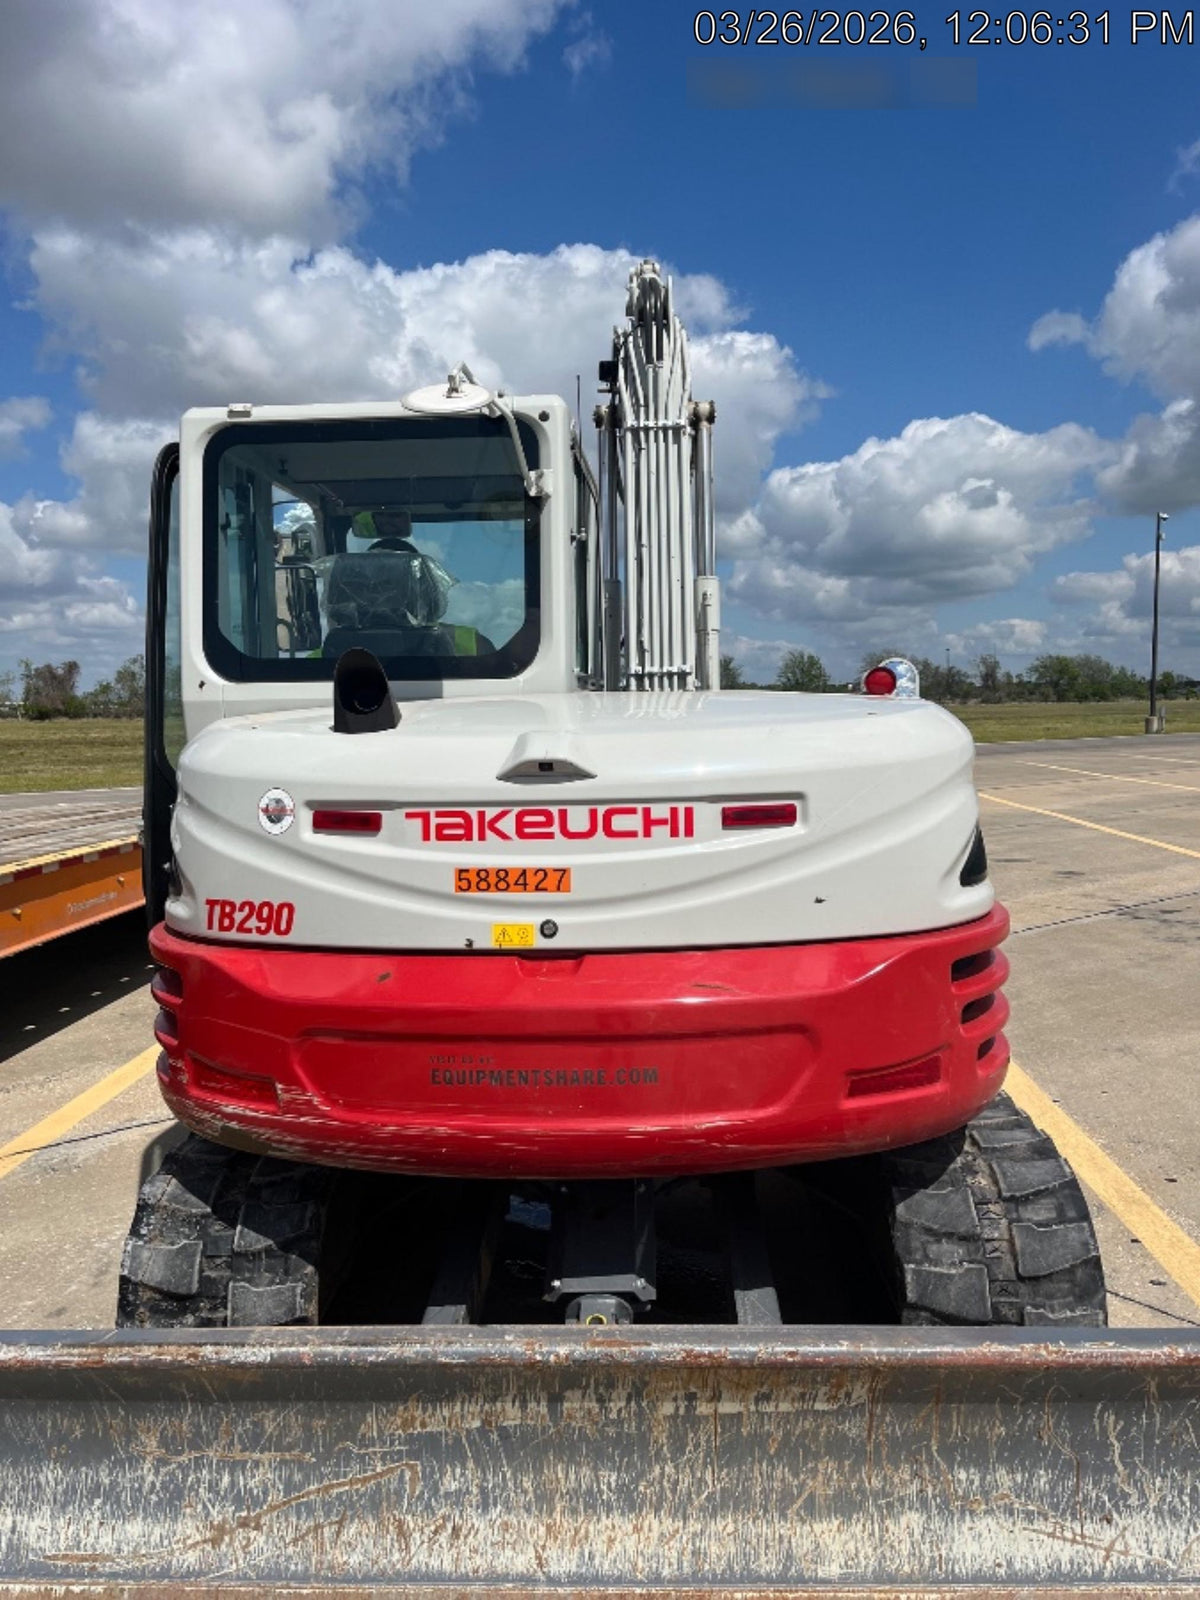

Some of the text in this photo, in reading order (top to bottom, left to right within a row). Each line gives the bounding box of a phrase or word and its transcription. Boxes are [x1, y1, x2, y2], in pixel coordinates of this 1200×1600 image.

[456, 868, 568, 893] 588427
[205, 898, 296, 936] TB290
[430, 1066, 660, 1087] EQUIPMENTSHARE.COM
